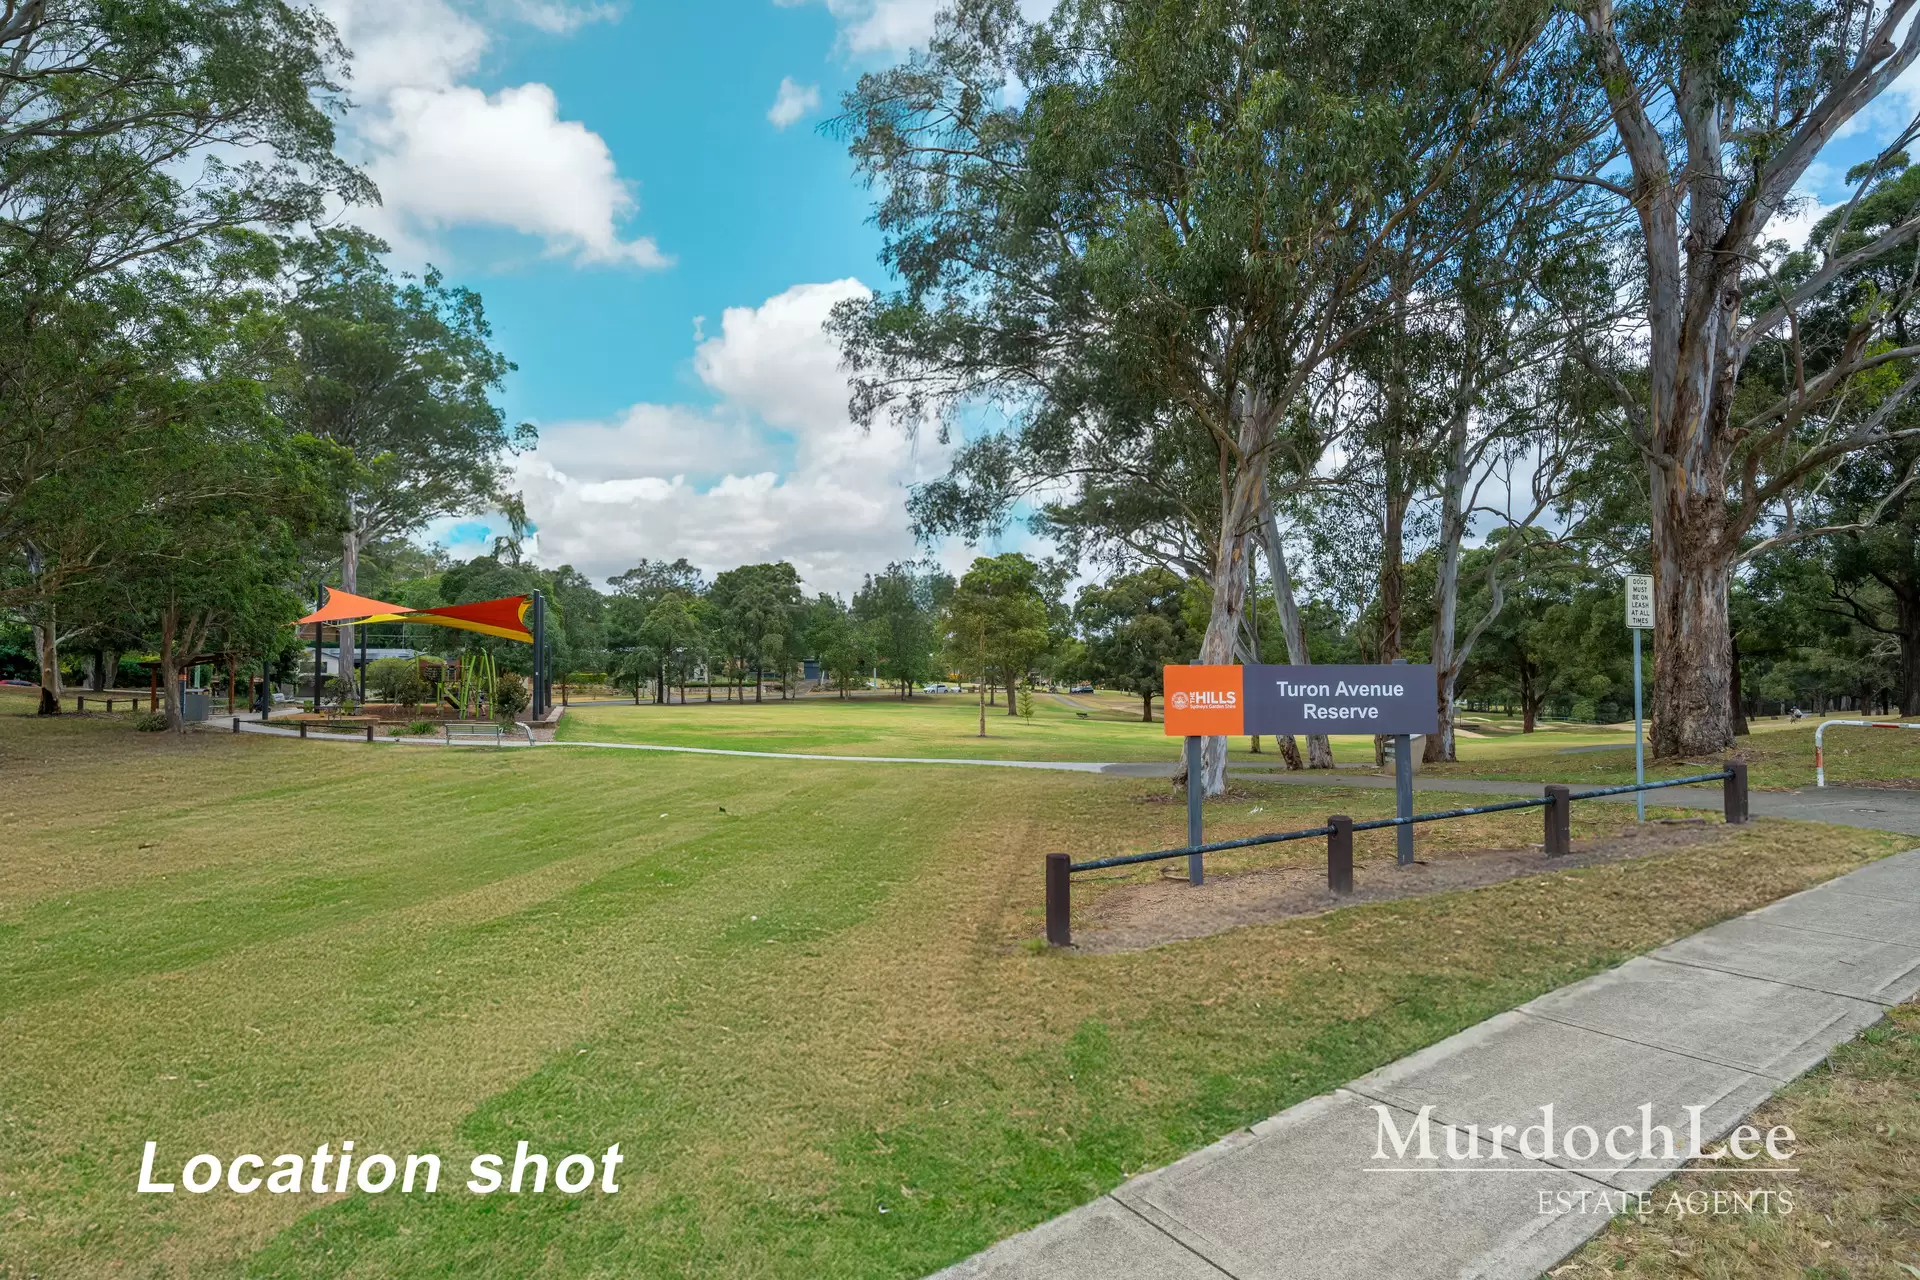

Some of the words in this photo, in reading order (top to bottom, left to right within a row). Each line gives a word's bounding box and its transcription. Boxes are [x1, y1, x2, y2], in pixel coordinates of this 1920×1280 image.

[1276, 681, 1329, 696] Turon
[1335, 681, 1404, 696] Avenue
[1196, 691, 1236, 704] HILLS
[1304, 704, 1379, 718] Reserve
